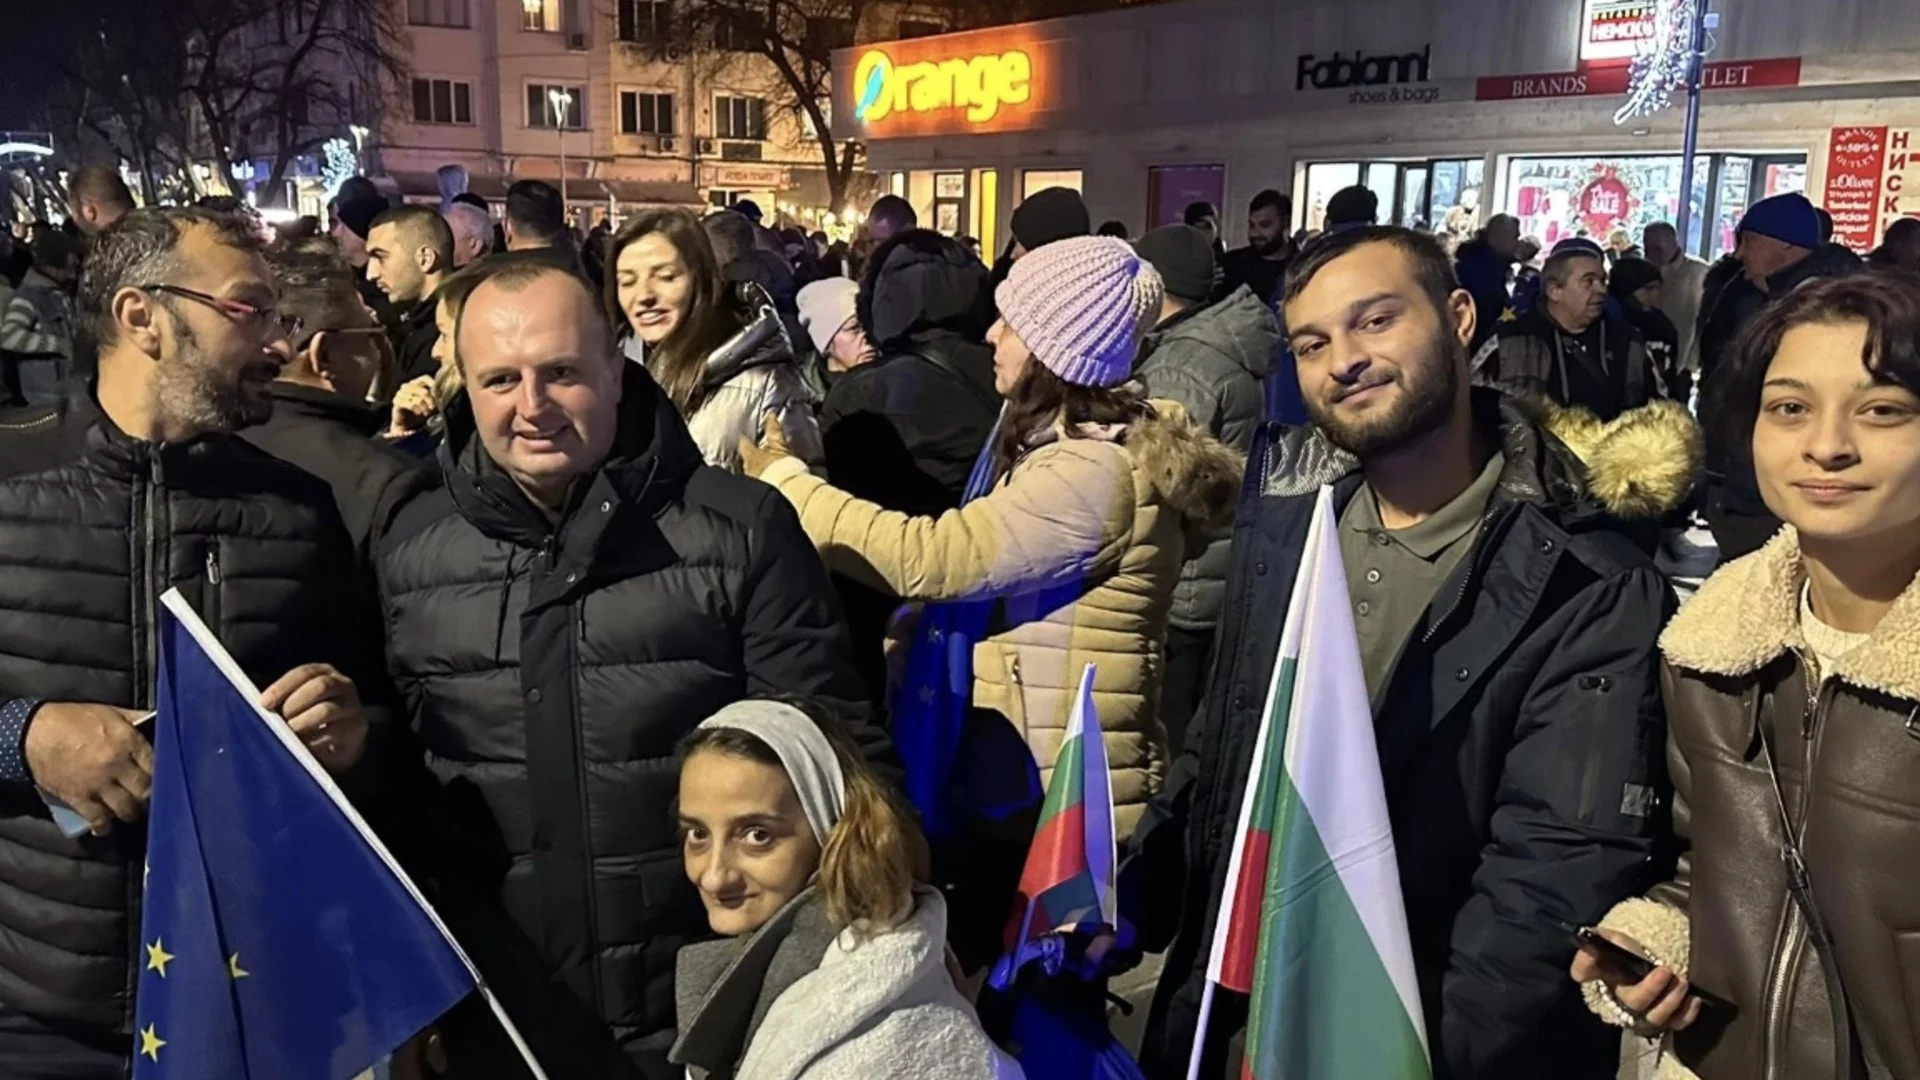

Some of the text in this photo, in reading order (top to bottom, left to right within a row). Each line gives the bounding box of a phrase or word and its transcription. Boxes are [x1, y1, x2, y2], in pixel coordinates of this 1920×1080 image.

[854, 50, 1031, 123] Orange
[1512, 66, 1753, 97] BRANDS TLET
[1350, 86, 1440, 104] shoes & bags
[1838, 128, 1878, 141] BRANDS
[1835, 154, 1875, 169] OUTLET
[1590, 198, 1619, 214] SALE
[1832, 223, 1870, 234] esigual
